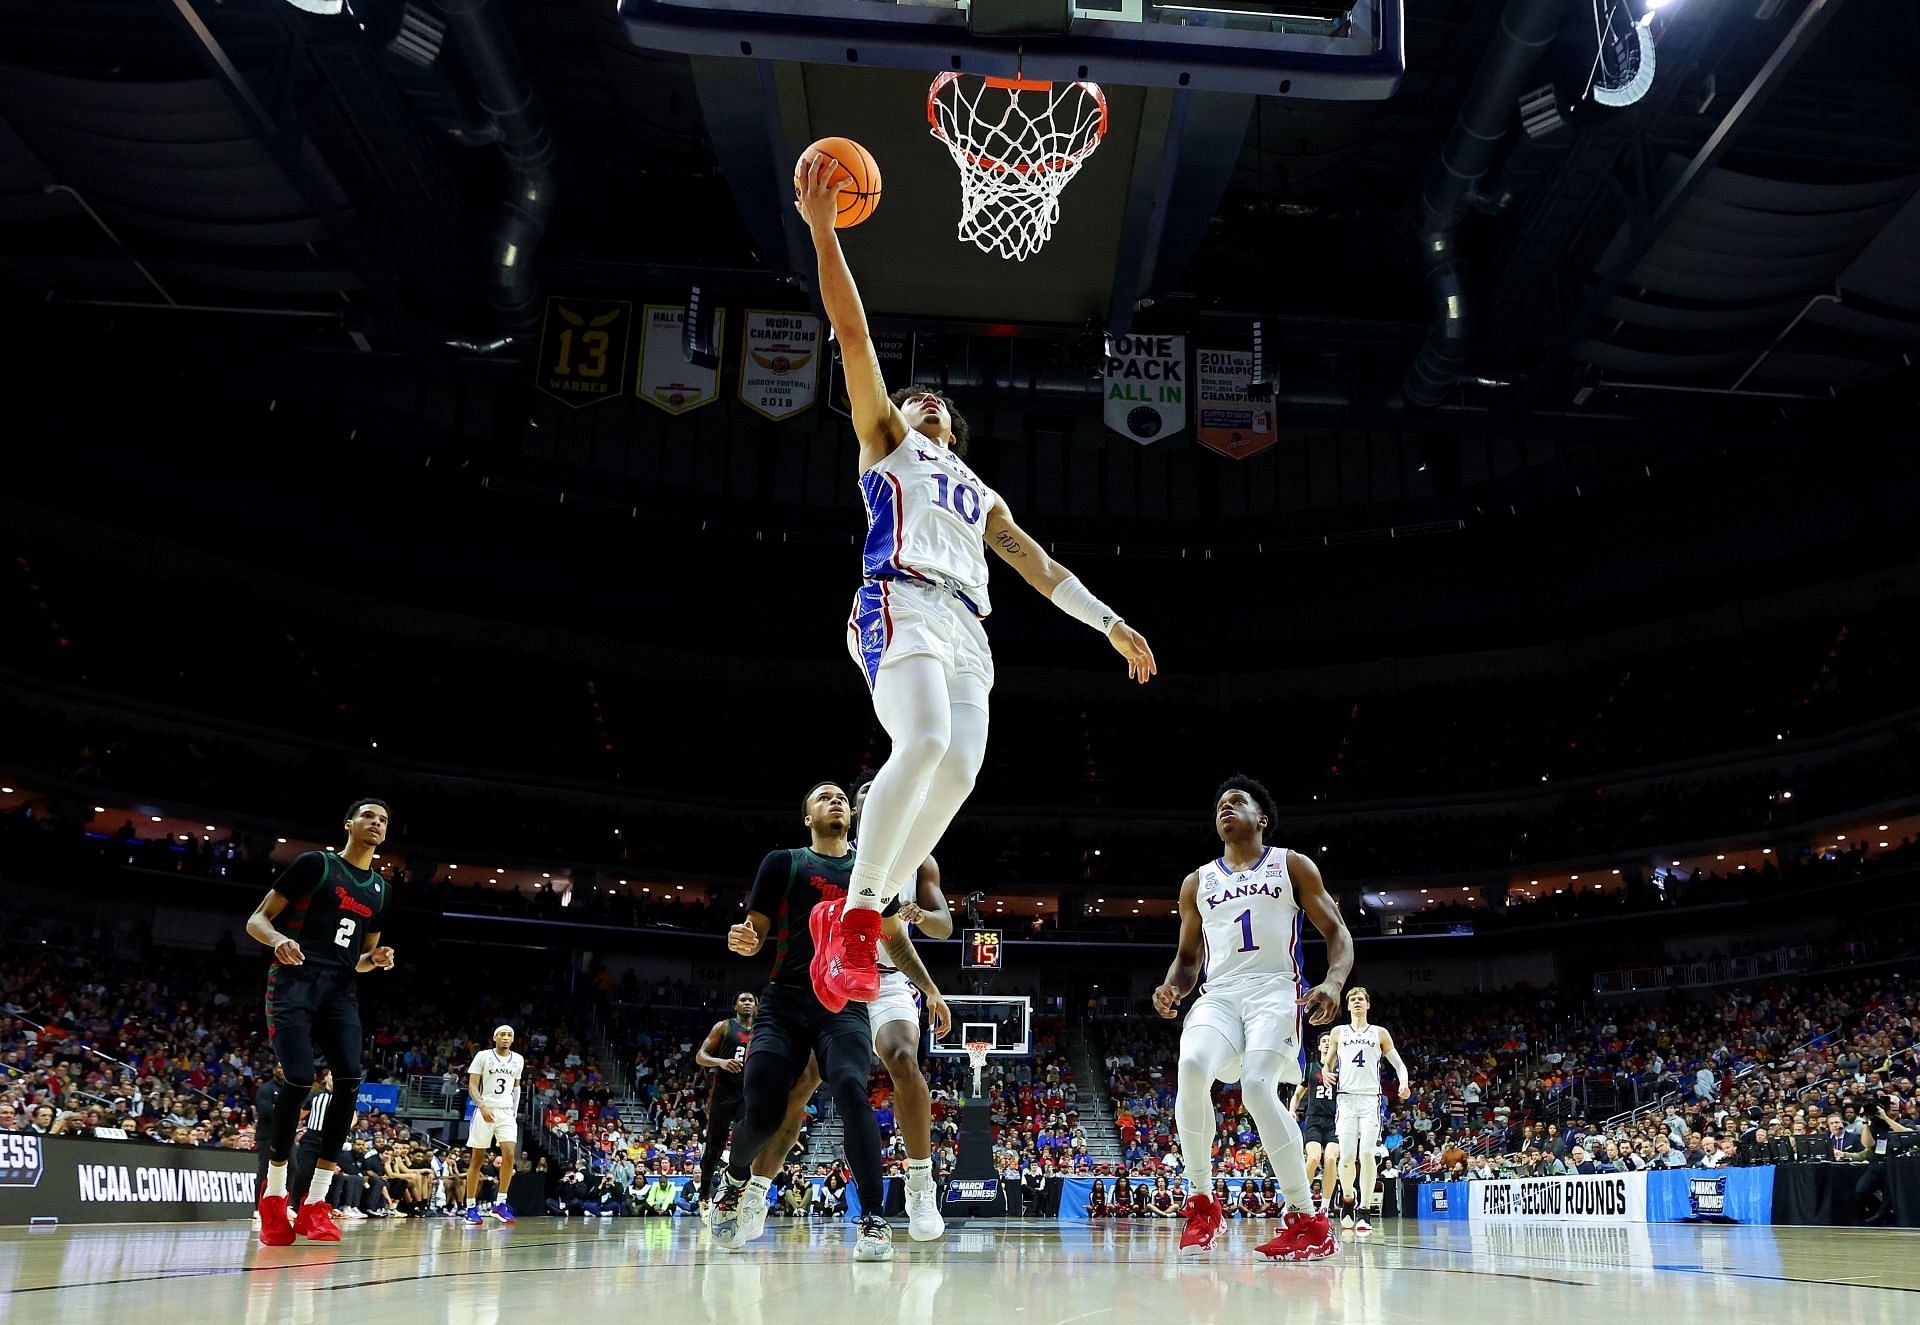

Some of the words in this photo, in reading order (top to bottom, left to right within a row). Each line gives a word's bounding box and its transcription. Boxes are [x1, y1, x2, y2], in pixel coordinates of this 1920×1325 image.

[653, 312, 675, 322] HALL
[766, 318, 802, 329] WORLD
[750, 329, 815, 342] CHAMPIONS
[554, 329, 609, 377] 13
[1115, 336, 1172, 358] ONE
[1201, 353, 1233, 365] 2011
[1107, 358, 1182, 381] PACK
[1201, 365, 1254, 376] CHAMPIO
[765, 387, 791, 395] LEAGUE
[776, 380, 810, 389] FOOTBALL
[1109, 384, 1153, 402] ALL
[1159, 385, 1181, 403] IN
[931, 473, 981, 525] 10
[1206, 883, 1282, 909] KANSAS
[333, 917, 356, 948] 2
[1234, 909, 1260, 952] 1
[974, 932, 999, 945] 3:55
[977, 945, 994, 964] 15
[1343, 1039, 1376, 1048] KANSAS
[1352, 1050, 1366, 1067] 4
[494, 1078, 506, 1095] 3
[1316, 1085, 1333, 1100] 24
[959, 1181, 985, 1190] MARCH
[961, 1189, 996, 1198] MADNESS
[1483, 1185, 1511, 1215] FIRST
[1521, 1181, 1561, 1215] SECOND
[1565, 1179, 1626, 1215] ROUNDS
[1698, 1195, 1725, 1209] MADNESS
